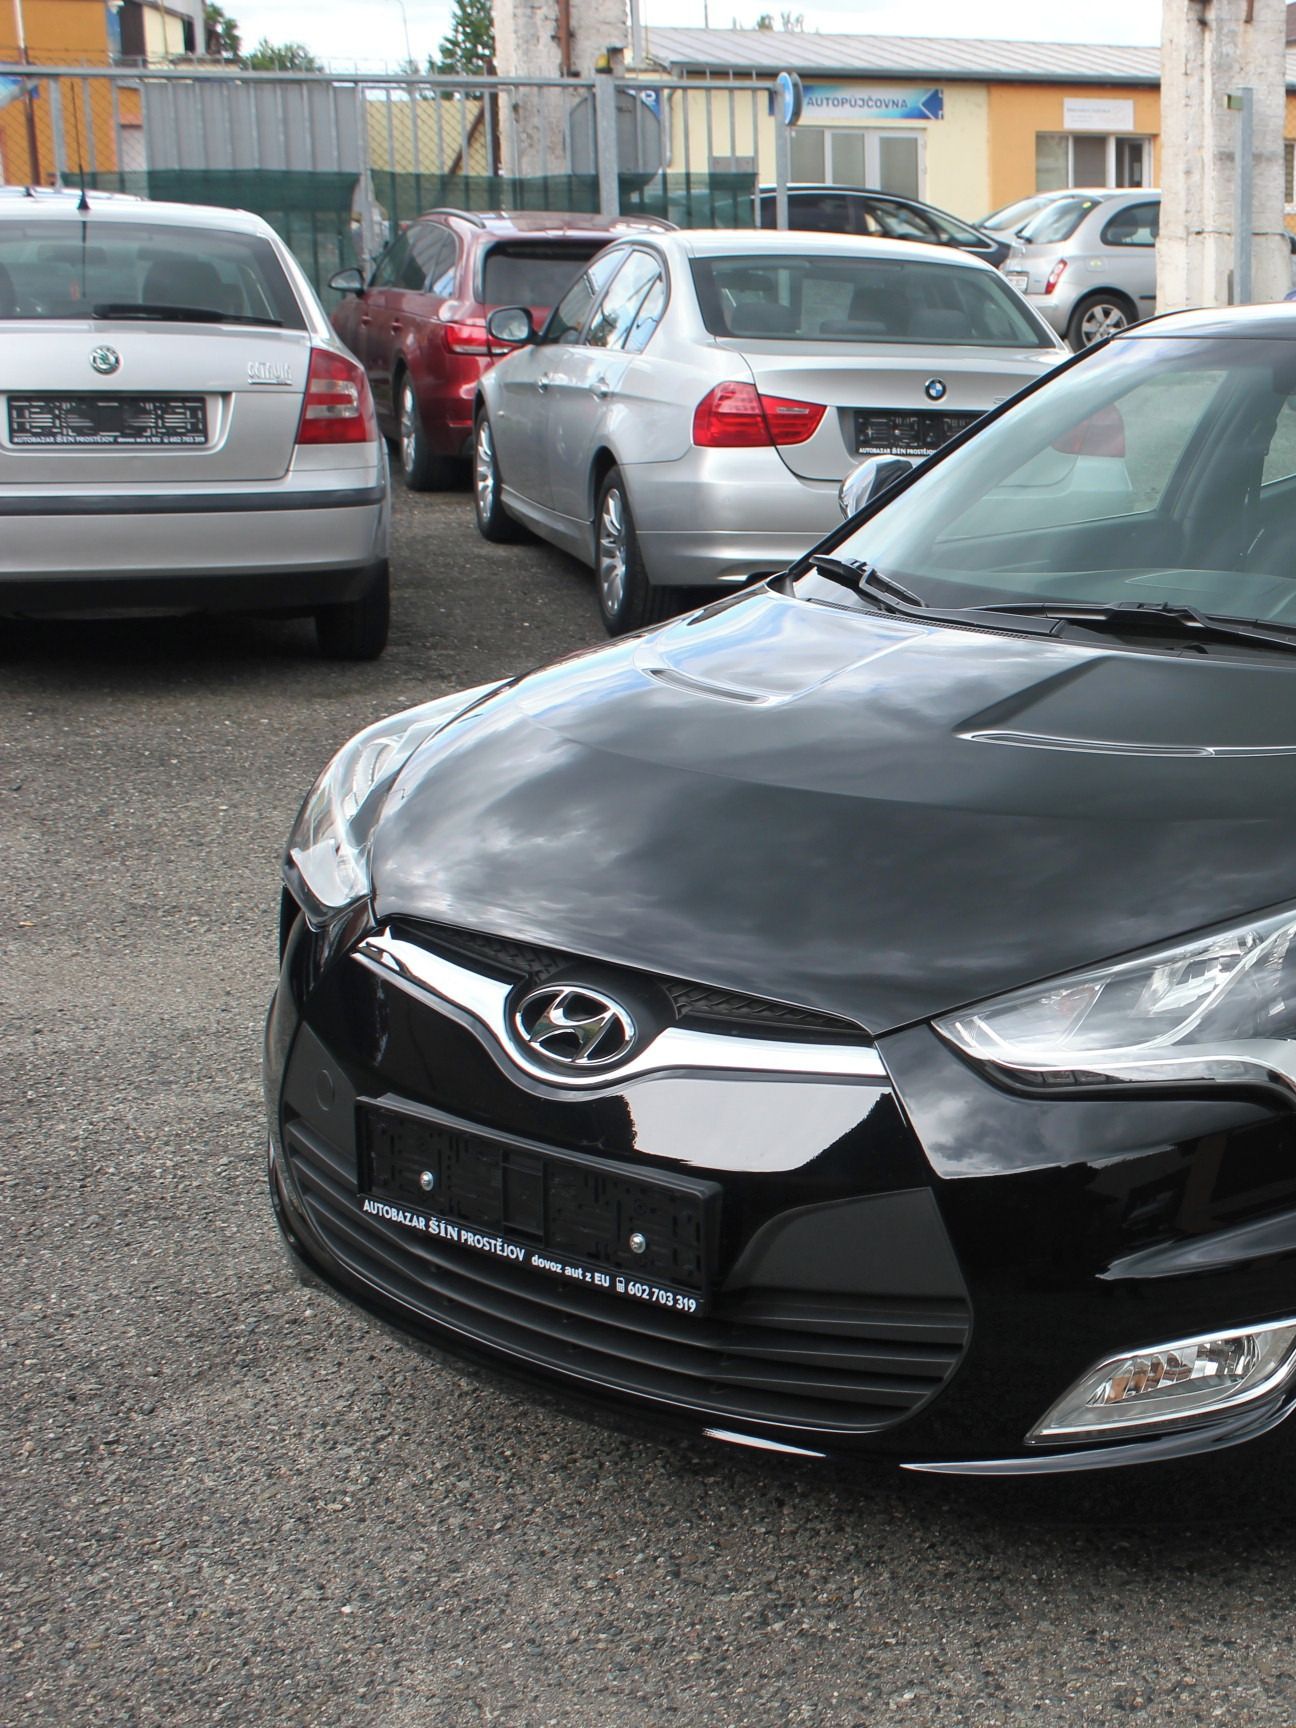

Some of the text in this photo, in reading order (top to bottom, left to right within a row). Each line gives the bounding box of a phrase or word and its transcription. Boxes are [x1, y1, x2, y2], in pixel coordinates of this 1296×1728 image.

[807, 95, 908, 108] AUTOPŮJČOVNA
[363, 1200, 697, 1313] AUTOBAZAR ŠÍN PROSTĚJOV dovoz aut z EU 602 703 319
